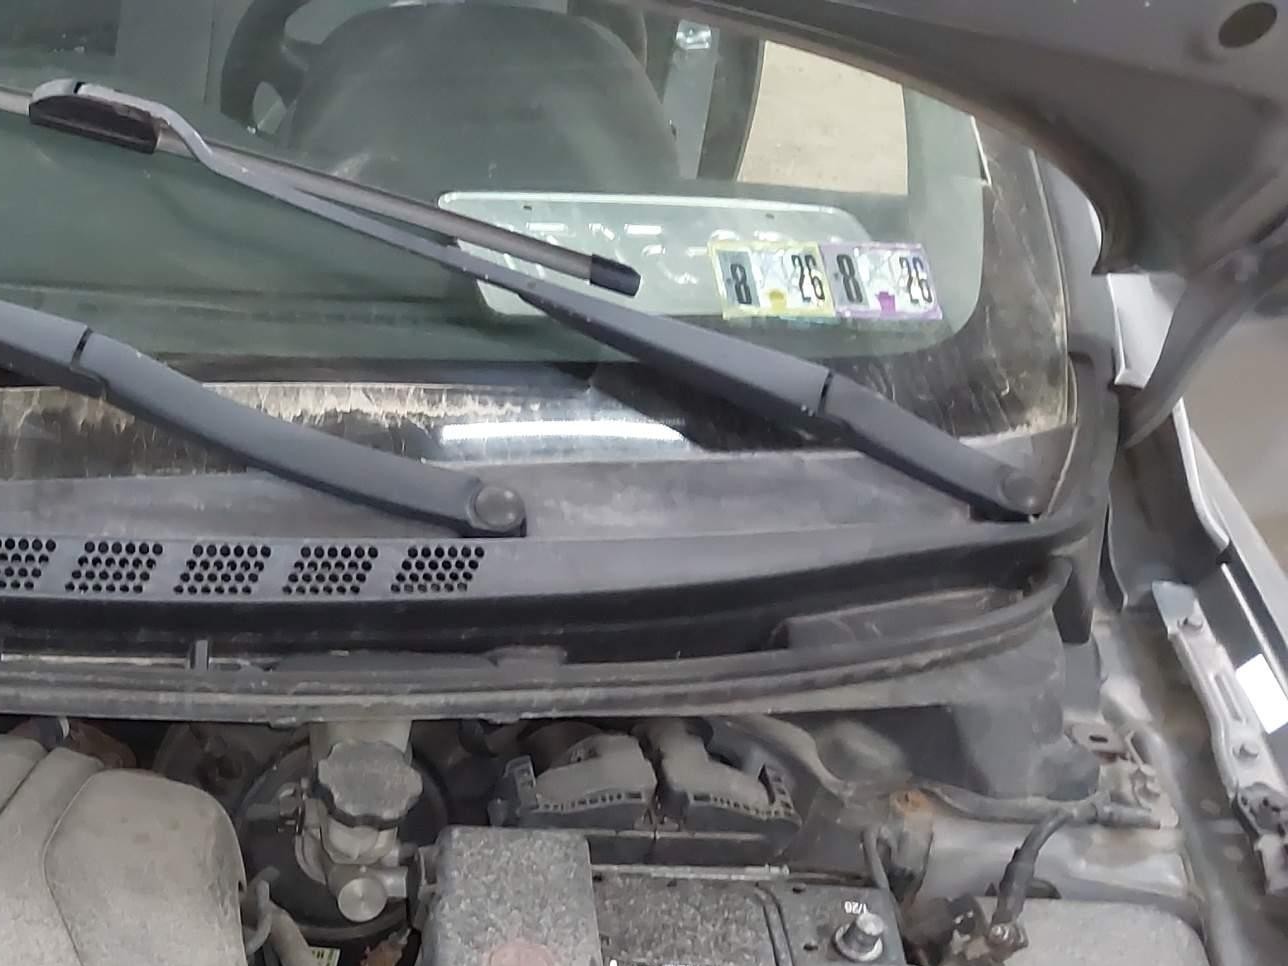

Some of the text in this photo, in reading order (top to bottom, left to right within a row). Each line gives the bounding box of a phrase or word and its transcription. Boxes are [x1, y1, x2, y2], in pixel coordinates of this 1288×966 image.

[731, 254, 825, 305] 8 26
[837, 254, 933, 304] 8 26
